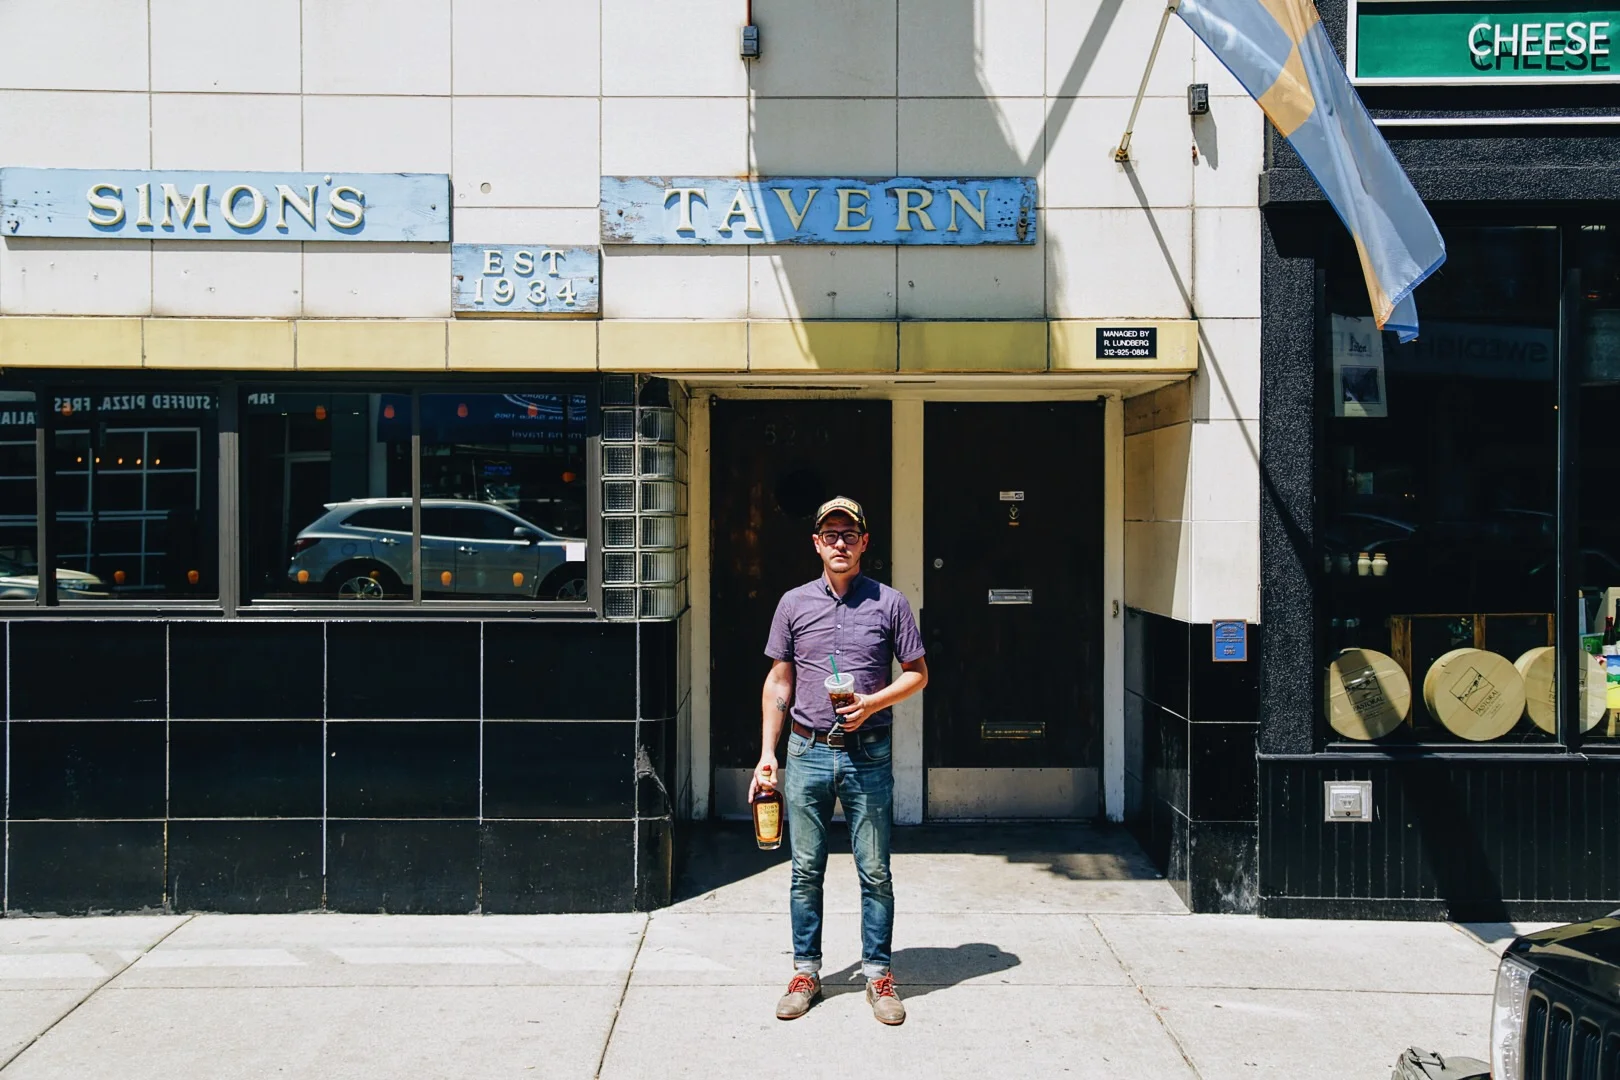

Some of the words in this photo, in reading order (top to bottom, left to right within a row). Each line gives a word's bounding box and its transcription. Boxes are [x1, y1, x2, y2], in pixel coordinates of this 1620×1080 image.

[1468, 22, 1610, 57] CHEESE
[85, 174, 365, 231] SIMON'S
[664, 187, 989, 233] TAVERN
[482, 250, 567, 276] EST
[473, 278, 578, 305] 1934
